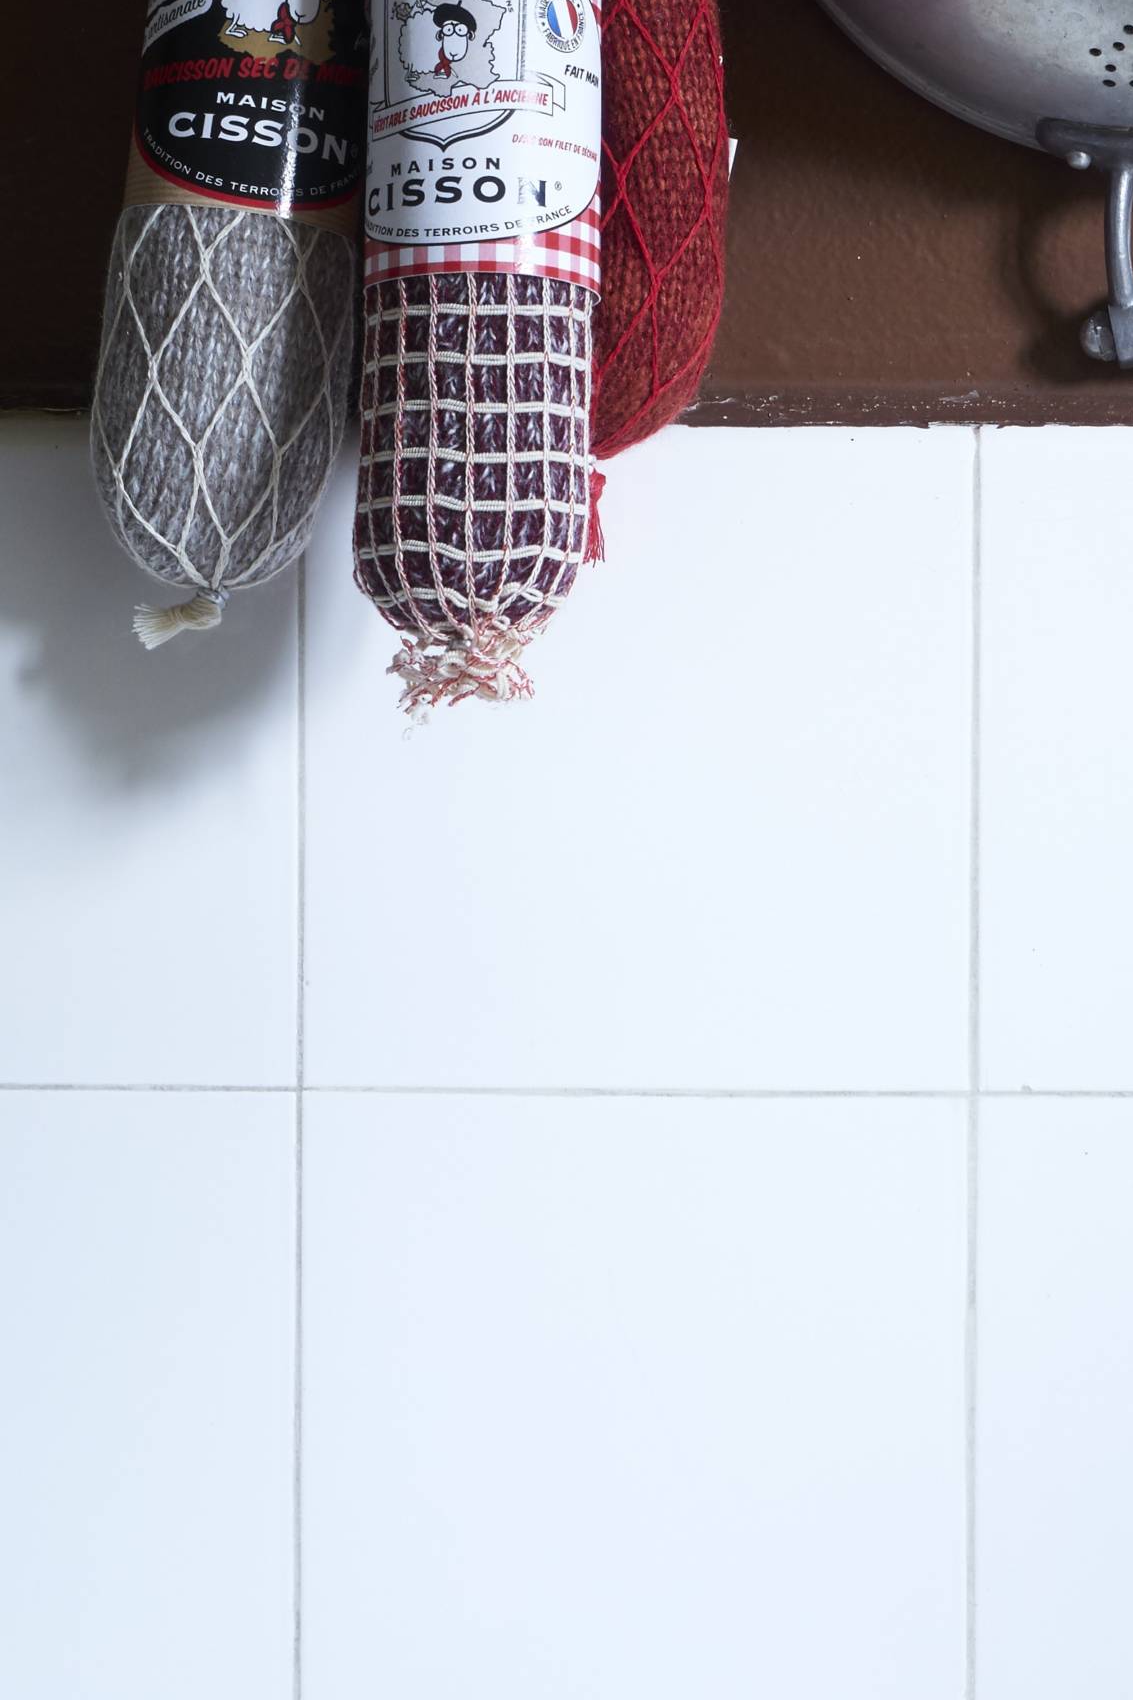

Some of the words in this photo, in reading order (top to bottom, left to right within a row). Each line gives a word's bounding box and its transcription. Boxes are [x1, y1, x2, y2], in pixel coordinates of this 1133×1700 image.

[237, 56, 278, 79] SEC
[564, 64, 585, 80] FAIT
[216, 91, 326, 122] MAISON
[410, 94, 469, 120] SAUCISSON
[483, 89, 549, 107] L'ANCIENE
[168, 111, 348, 166] CISSON
[539, 137, 554, 148] SON
[554, 140, 573, 153] FILET
[143, 125, 192, 176] TRADITION
[195, 171, 224, 187] DES
[229, 181, 304, 198] TERROS
[310, 186, 328, 196] DE
[391, 157, 501, 177] MAISON
[368, 176, 547, 217] CISSON
[396, 228, 421, 237] DES
[425, 222, 500, 237] TERROIRS
[505, 218, 522, 230] DE
[534, 205, 572, 226] RANCE
